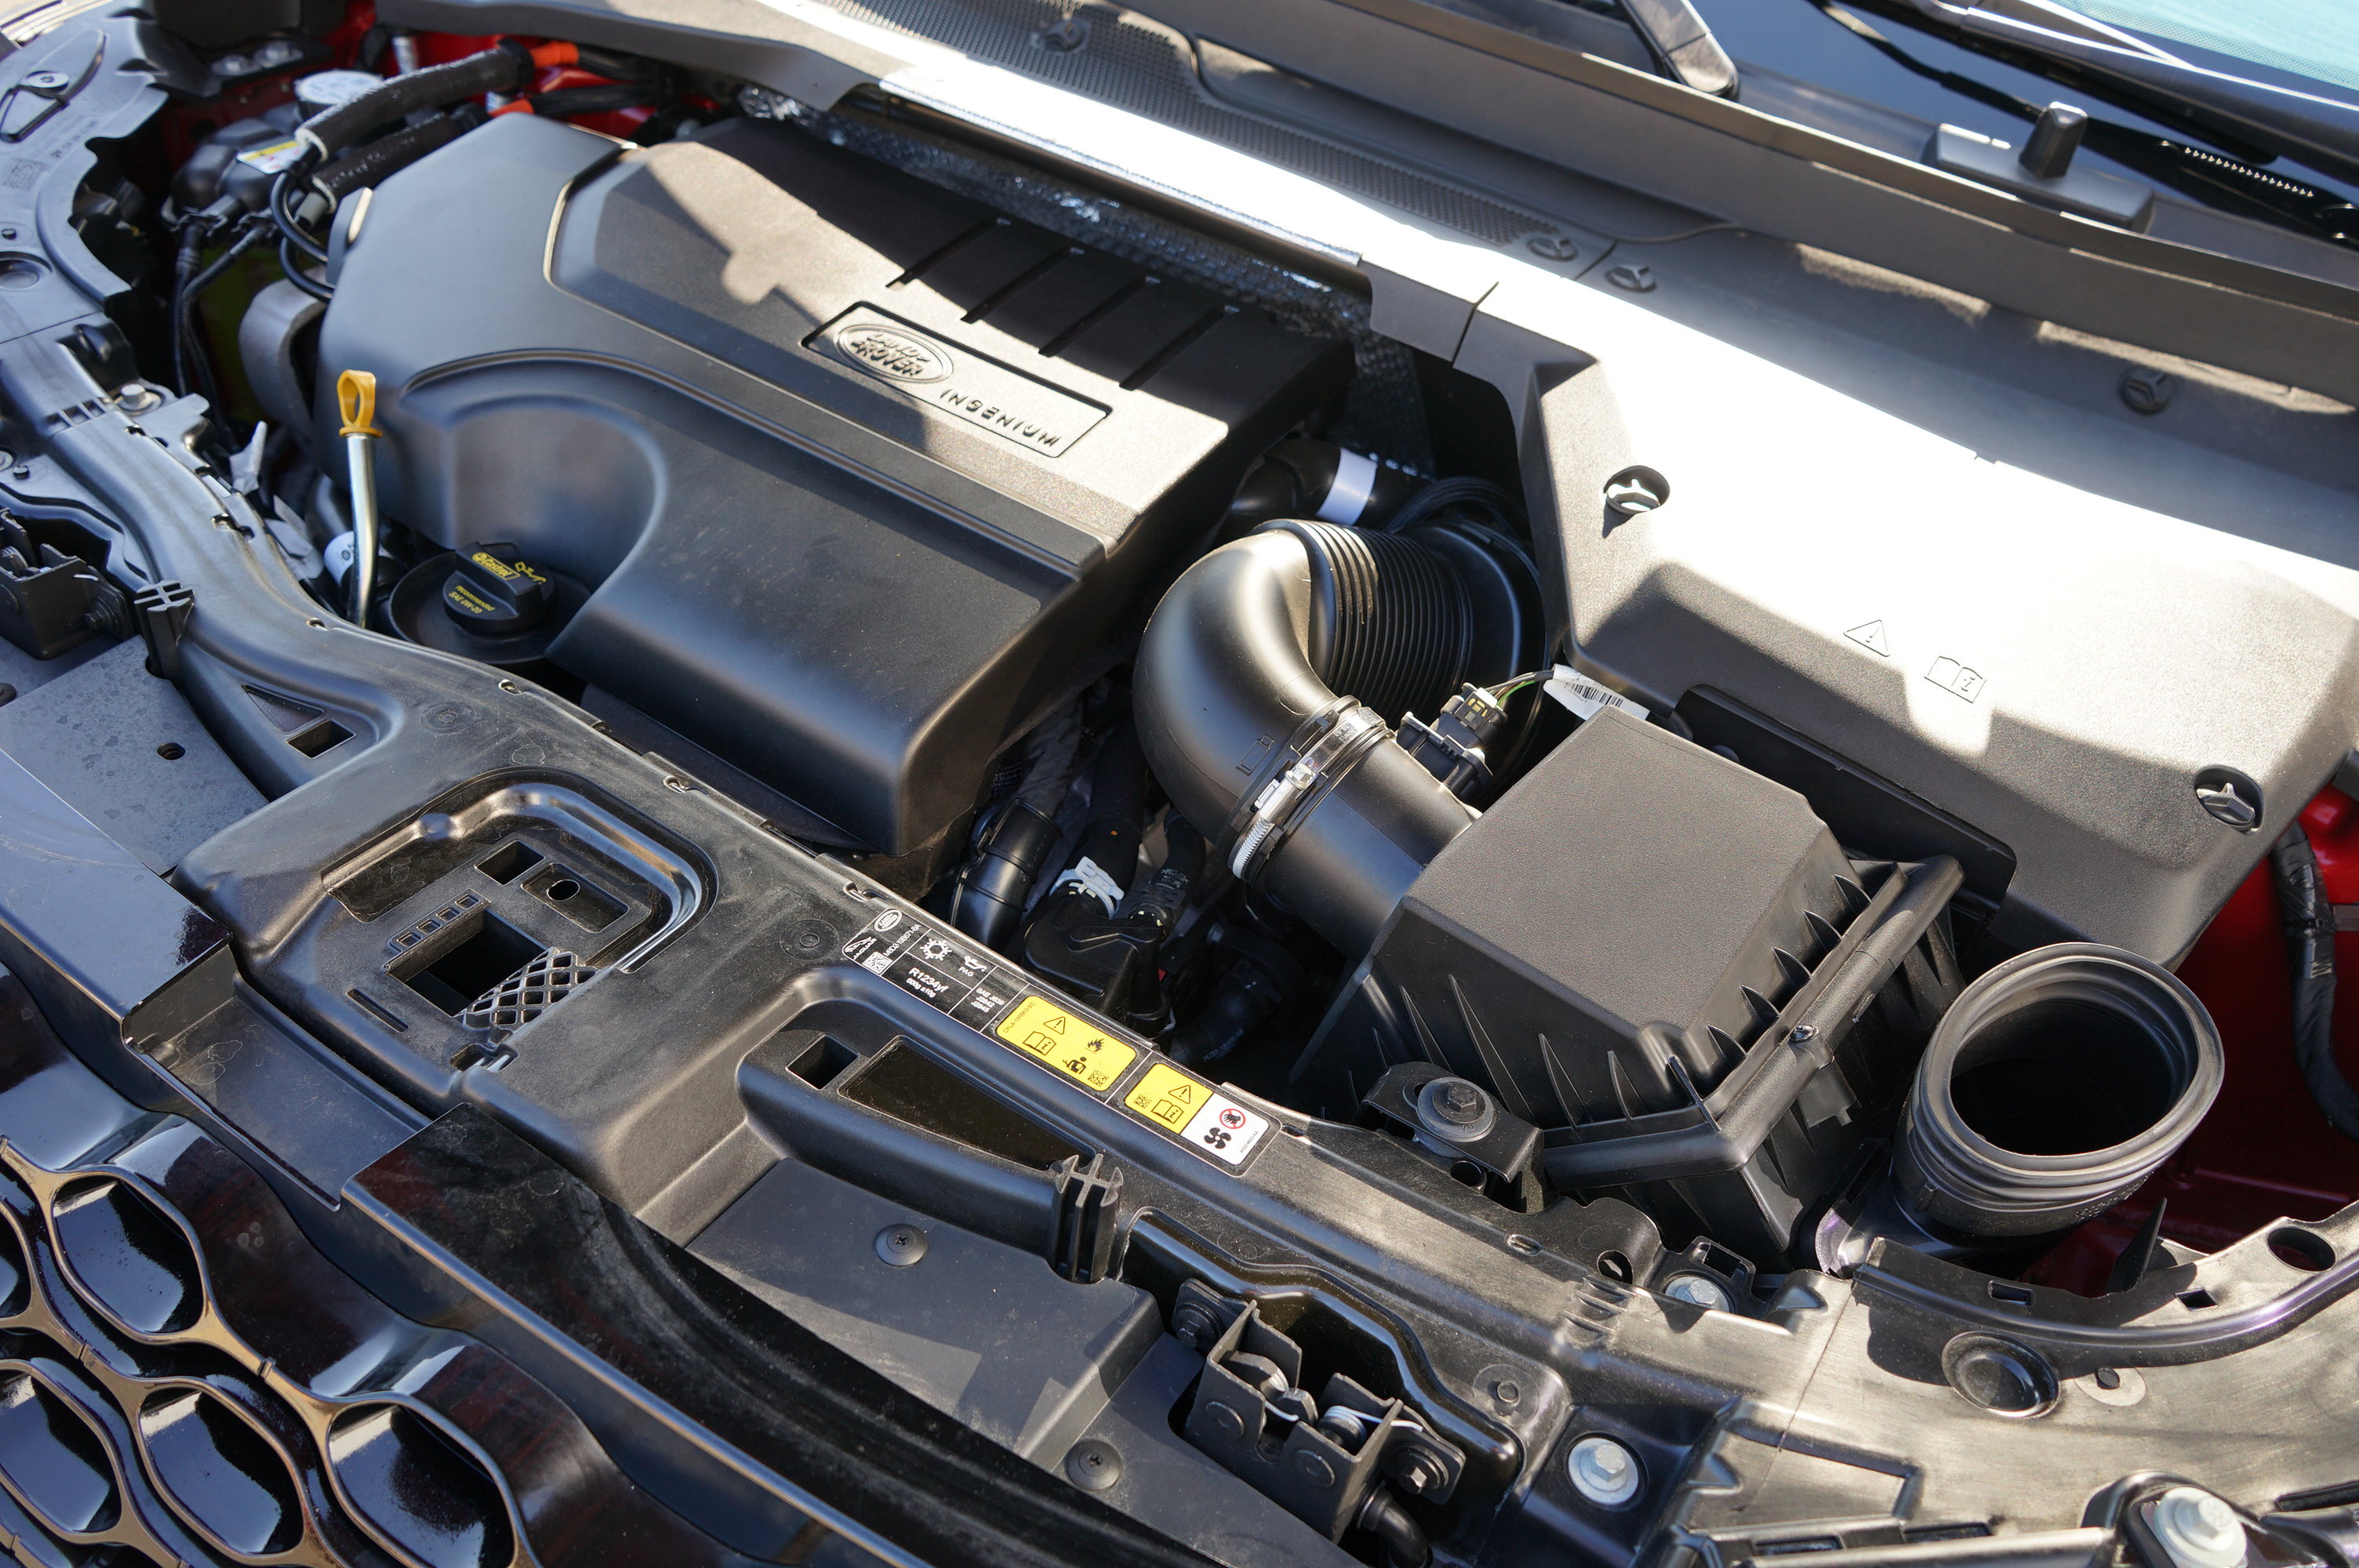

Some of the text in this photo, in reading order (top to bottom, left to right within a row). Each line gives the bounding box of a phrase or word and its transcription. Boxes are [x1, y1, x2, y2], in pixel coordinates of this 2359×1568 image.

[856, 341, 924, 376] ROVER
[852, 938, 878, 960] JAGUAR
[908, 967, 950, 993] R1234yf
[958, 966, 974, 978] PAG
[976, 988, 991, 998] SAE
